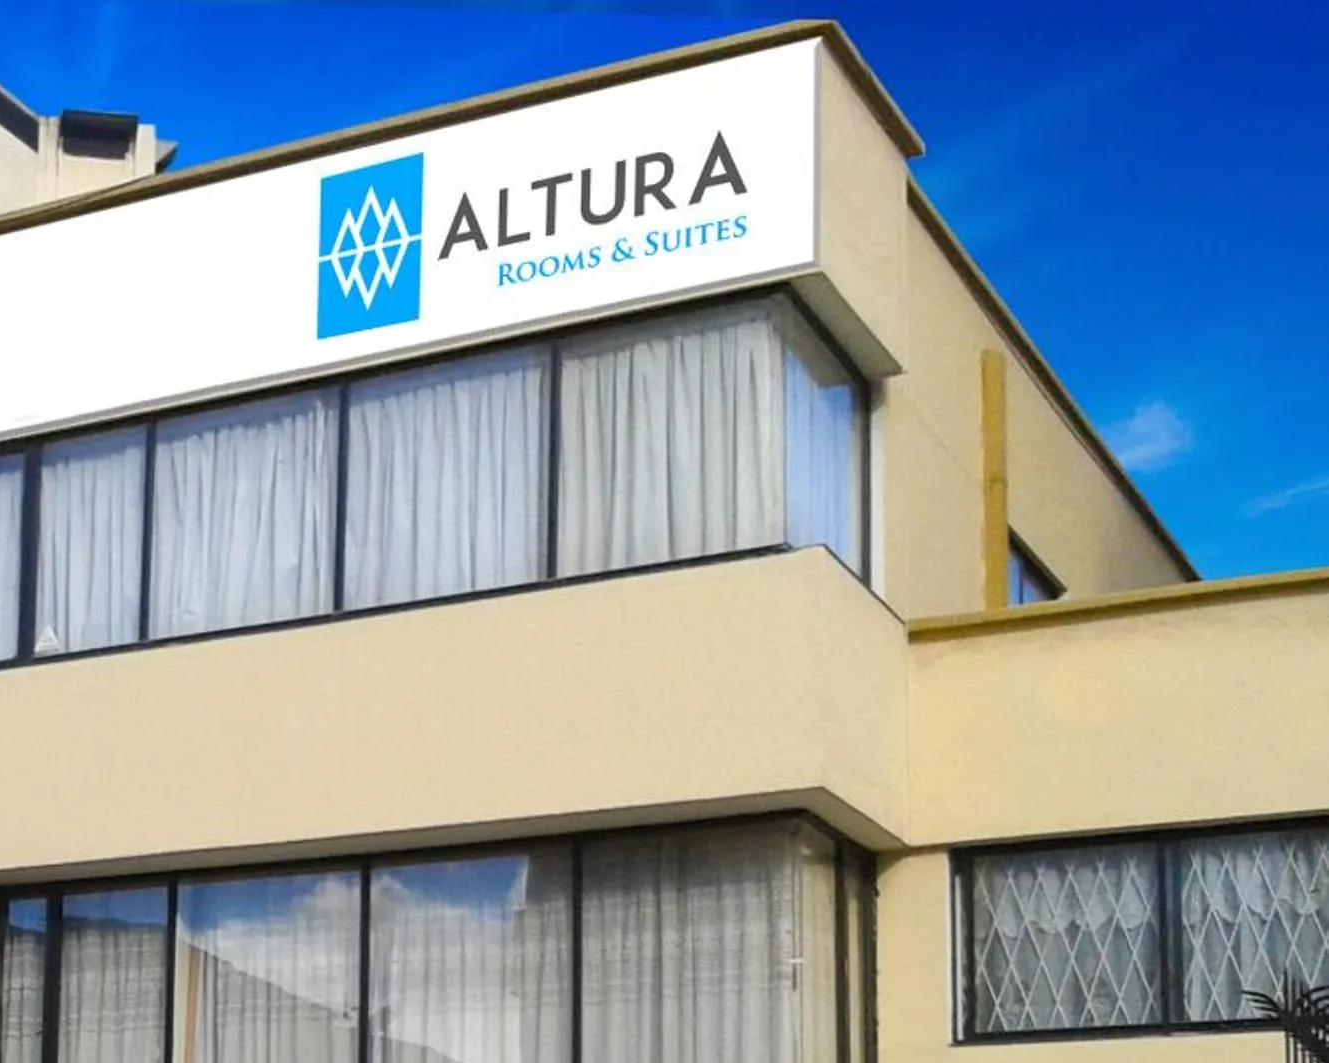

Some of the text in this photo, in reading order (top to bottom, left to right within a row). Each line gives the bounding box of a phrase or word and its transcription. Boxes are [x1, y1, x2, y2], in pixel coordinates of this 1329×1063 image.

[439, 131, 747, 260] ALTURA
[498, 216, 747, 286] ROOMS & SUITES
